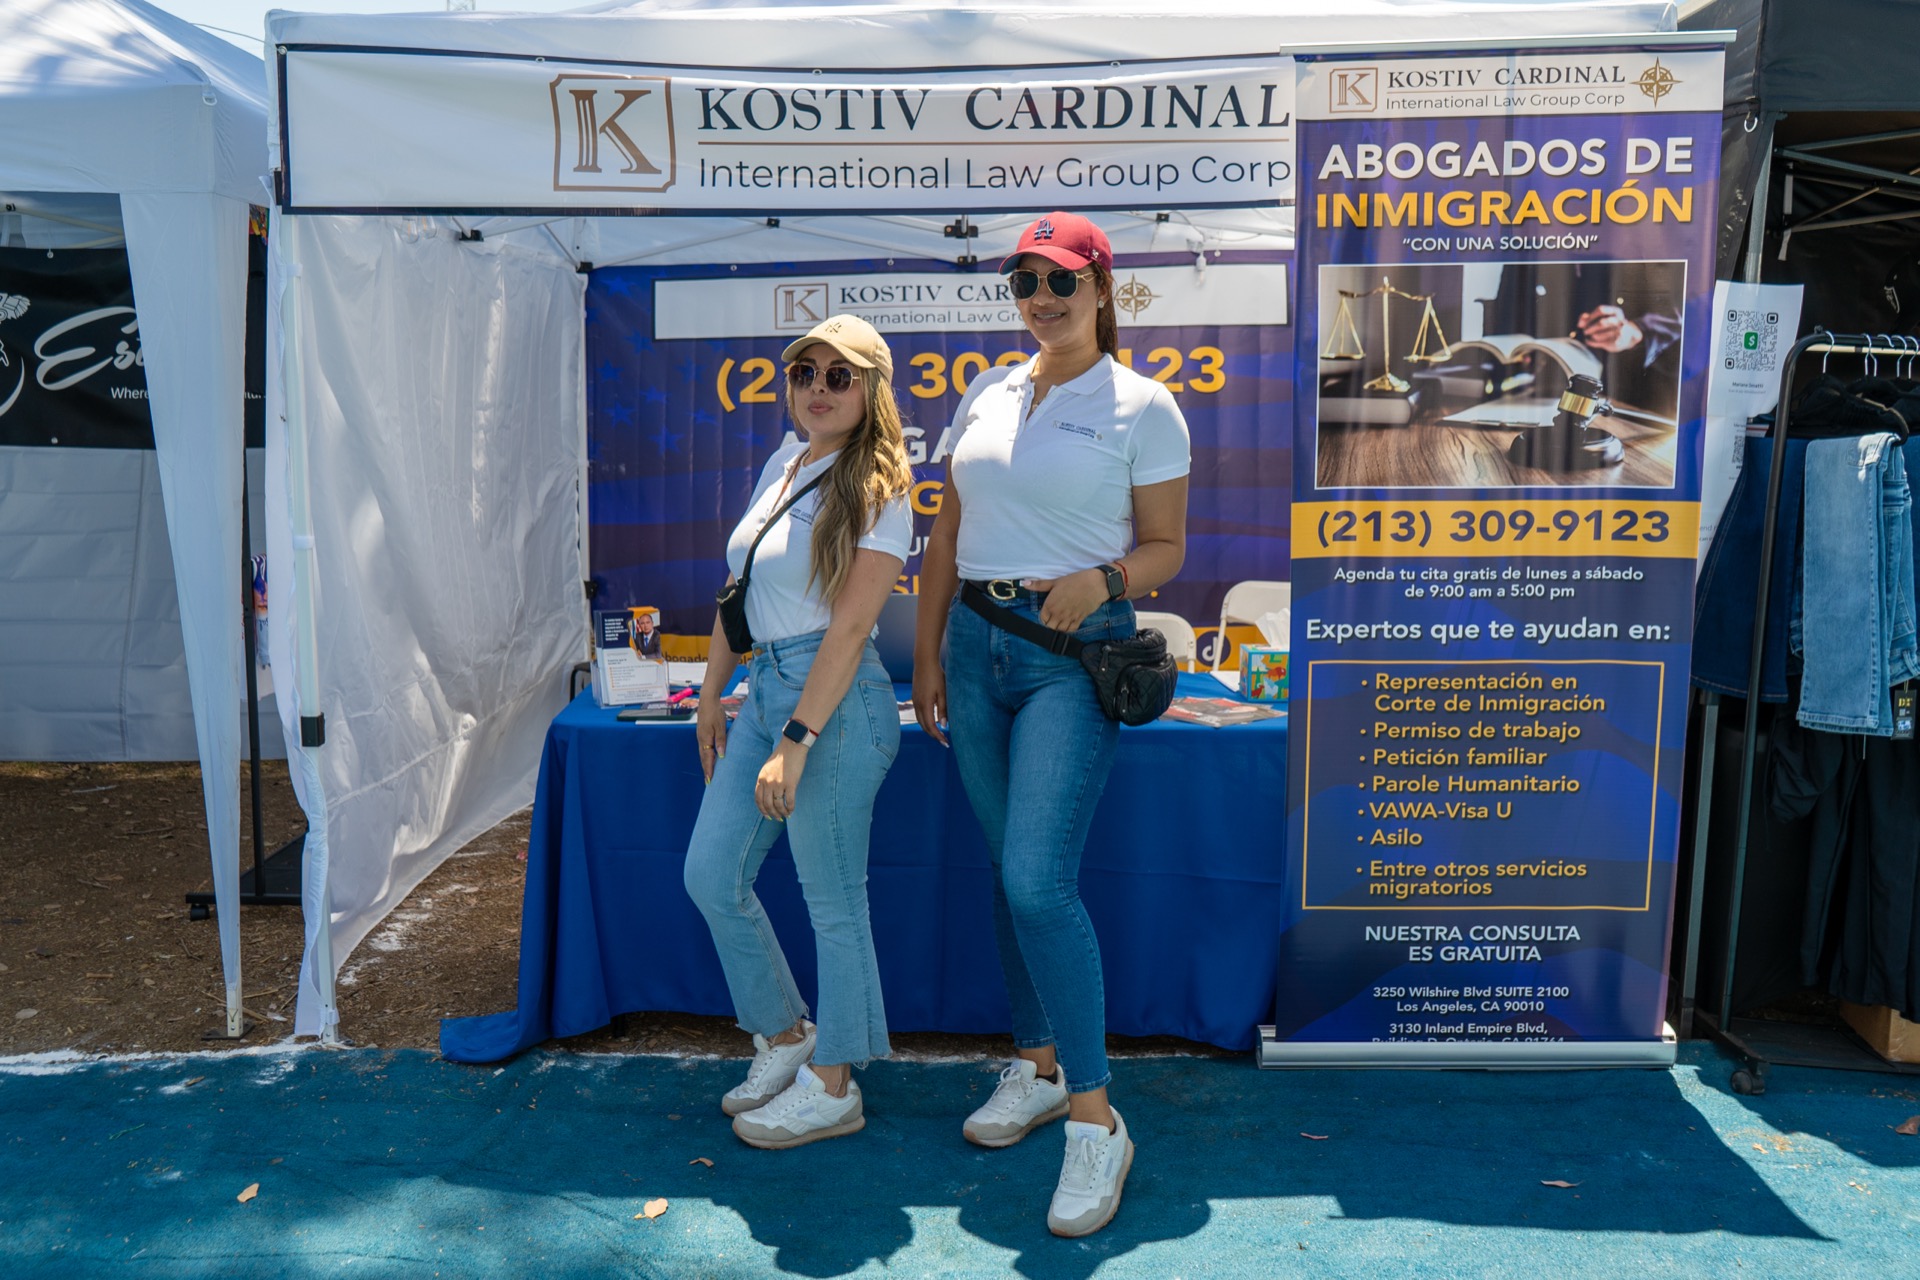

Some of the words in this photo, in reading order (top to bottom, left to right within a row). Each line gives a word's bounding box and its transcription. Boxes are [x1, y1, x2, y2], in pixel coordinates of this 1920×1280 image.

[1387, 69, 1482, 90] KOSTIV
[1494, 65, 1626, 86] CARDINAL
[696, 87, 931, 132] KOSTIV
[964, 84, 1290, 130] CARDINAL
[1386, 97, 1489, 110] International
[1494, 95, 1526, 108] Law
[1530, 94, 1581, 110] Group
[1584, 92, 1626, 108] Corp
[1318, 138, 1606, 180] ABOGADOS
[1626, 137, 1693, 173] DE
[699, 157, 950, 189] International
[965, 158, 1044, 189] Law
[1056, 157, 1178, 191] Group
[1191, 155, 1292, 189] Corp
[1316, 180, 1694, 228] INMIGRACIÓN
[1456, 237, 1494, 251] UNA
[840, 285, 942, 304] KOSTIV
[958, 309, 993, 324] Law
[1317, 509, 1432, 548] (213)
[1449, 509, 1671, 542] 309-9123
[1334, 567, 1395, 583] Agenda
[1400, 567, 1416, 580] tu
[1420, 566, 1448, 580] cita
[1453, 566, 1497, 583] gratis
[1501, 566, 1521, 580] de
[1526, 566, 1567, 580] lunes
[1571, 570, 1580, 580] a
[1585, 565, 1643, 580] sábado
[1404, 583, 1424, 598] de
[1429, 583, 1464, 598] 9:00
[1469, 587, 1491, 598] am
[1496, 587, 1505, 597] a
[1510, 583, 1545, 597] 5:00
[1550, 587, 1575, 600] pm
[1307, 619, 1421, 645] Expertos
[1431, 623, 1480, 645] que
[1488, 619, 1514, 639] te
[1524, 616, 1618, 643] ayudan
[1628, 622, 1670, 640] en:
[1375, 672, 1543, 693] Representación
[1551, 675, 1577, 690] en
[1374, 694, 1436, 712] Corte
[1444, 694, 1471, 711] de
[1480, 692, 1605, 715] Inmigración
[1374, 721, 1461, 740] Permiso
[1468, 720, 1496, 738] de
[1502, 721, 1581, 743] trabajo
[1373, 748, 1459, 766] Petición
[1467, 748, 1547, 766] familiar
[1372, 774, 1440, 793] Parole
[1448, 773, 1580, 793] Humanitario
[1370, 801, 1489, 819] VAWA-Visa
[1496, 801, 1512, 818] U
[1370, 828, 1423, 846] Asilo
[1370, 860, 1427, 878] Entre
[1433, 861, 1489, 877] otros
[1496, 860, 1587, 877] servicios
[1369, 879, 1492, 899] migratorios
[1365, 924, 1463, 942] NUESTRA
[1469, 924, 1580, 941] CONSULTA
[1409, 945, 1433, 962] ES
[1440, 945, 1541, 962] GRATUITA
[1373, 986, 1405, 998] 3250
[1409, 986, 1460, 998] Wilshire
[1464, 986, 1491, 998] Blvd
[1495, 986, 1532, 998] SUITE
[1537, 986, 1569, 998] 2100
[1397, 1001, 1419, 1012] Los
[1422, 1001, 1477, 1015] Angeles,
[1481, 1001, 1500, 1012] CA
[1504, 1001, 1544, 1012] 90010
[1389, 1023, 1421, 1034] 3130
[1425, 1023, 1464, 1034] Inland
[1468, 1023, 1513, 1036] Empire
[1516, 1023, 1548, 1035] Blvd,
